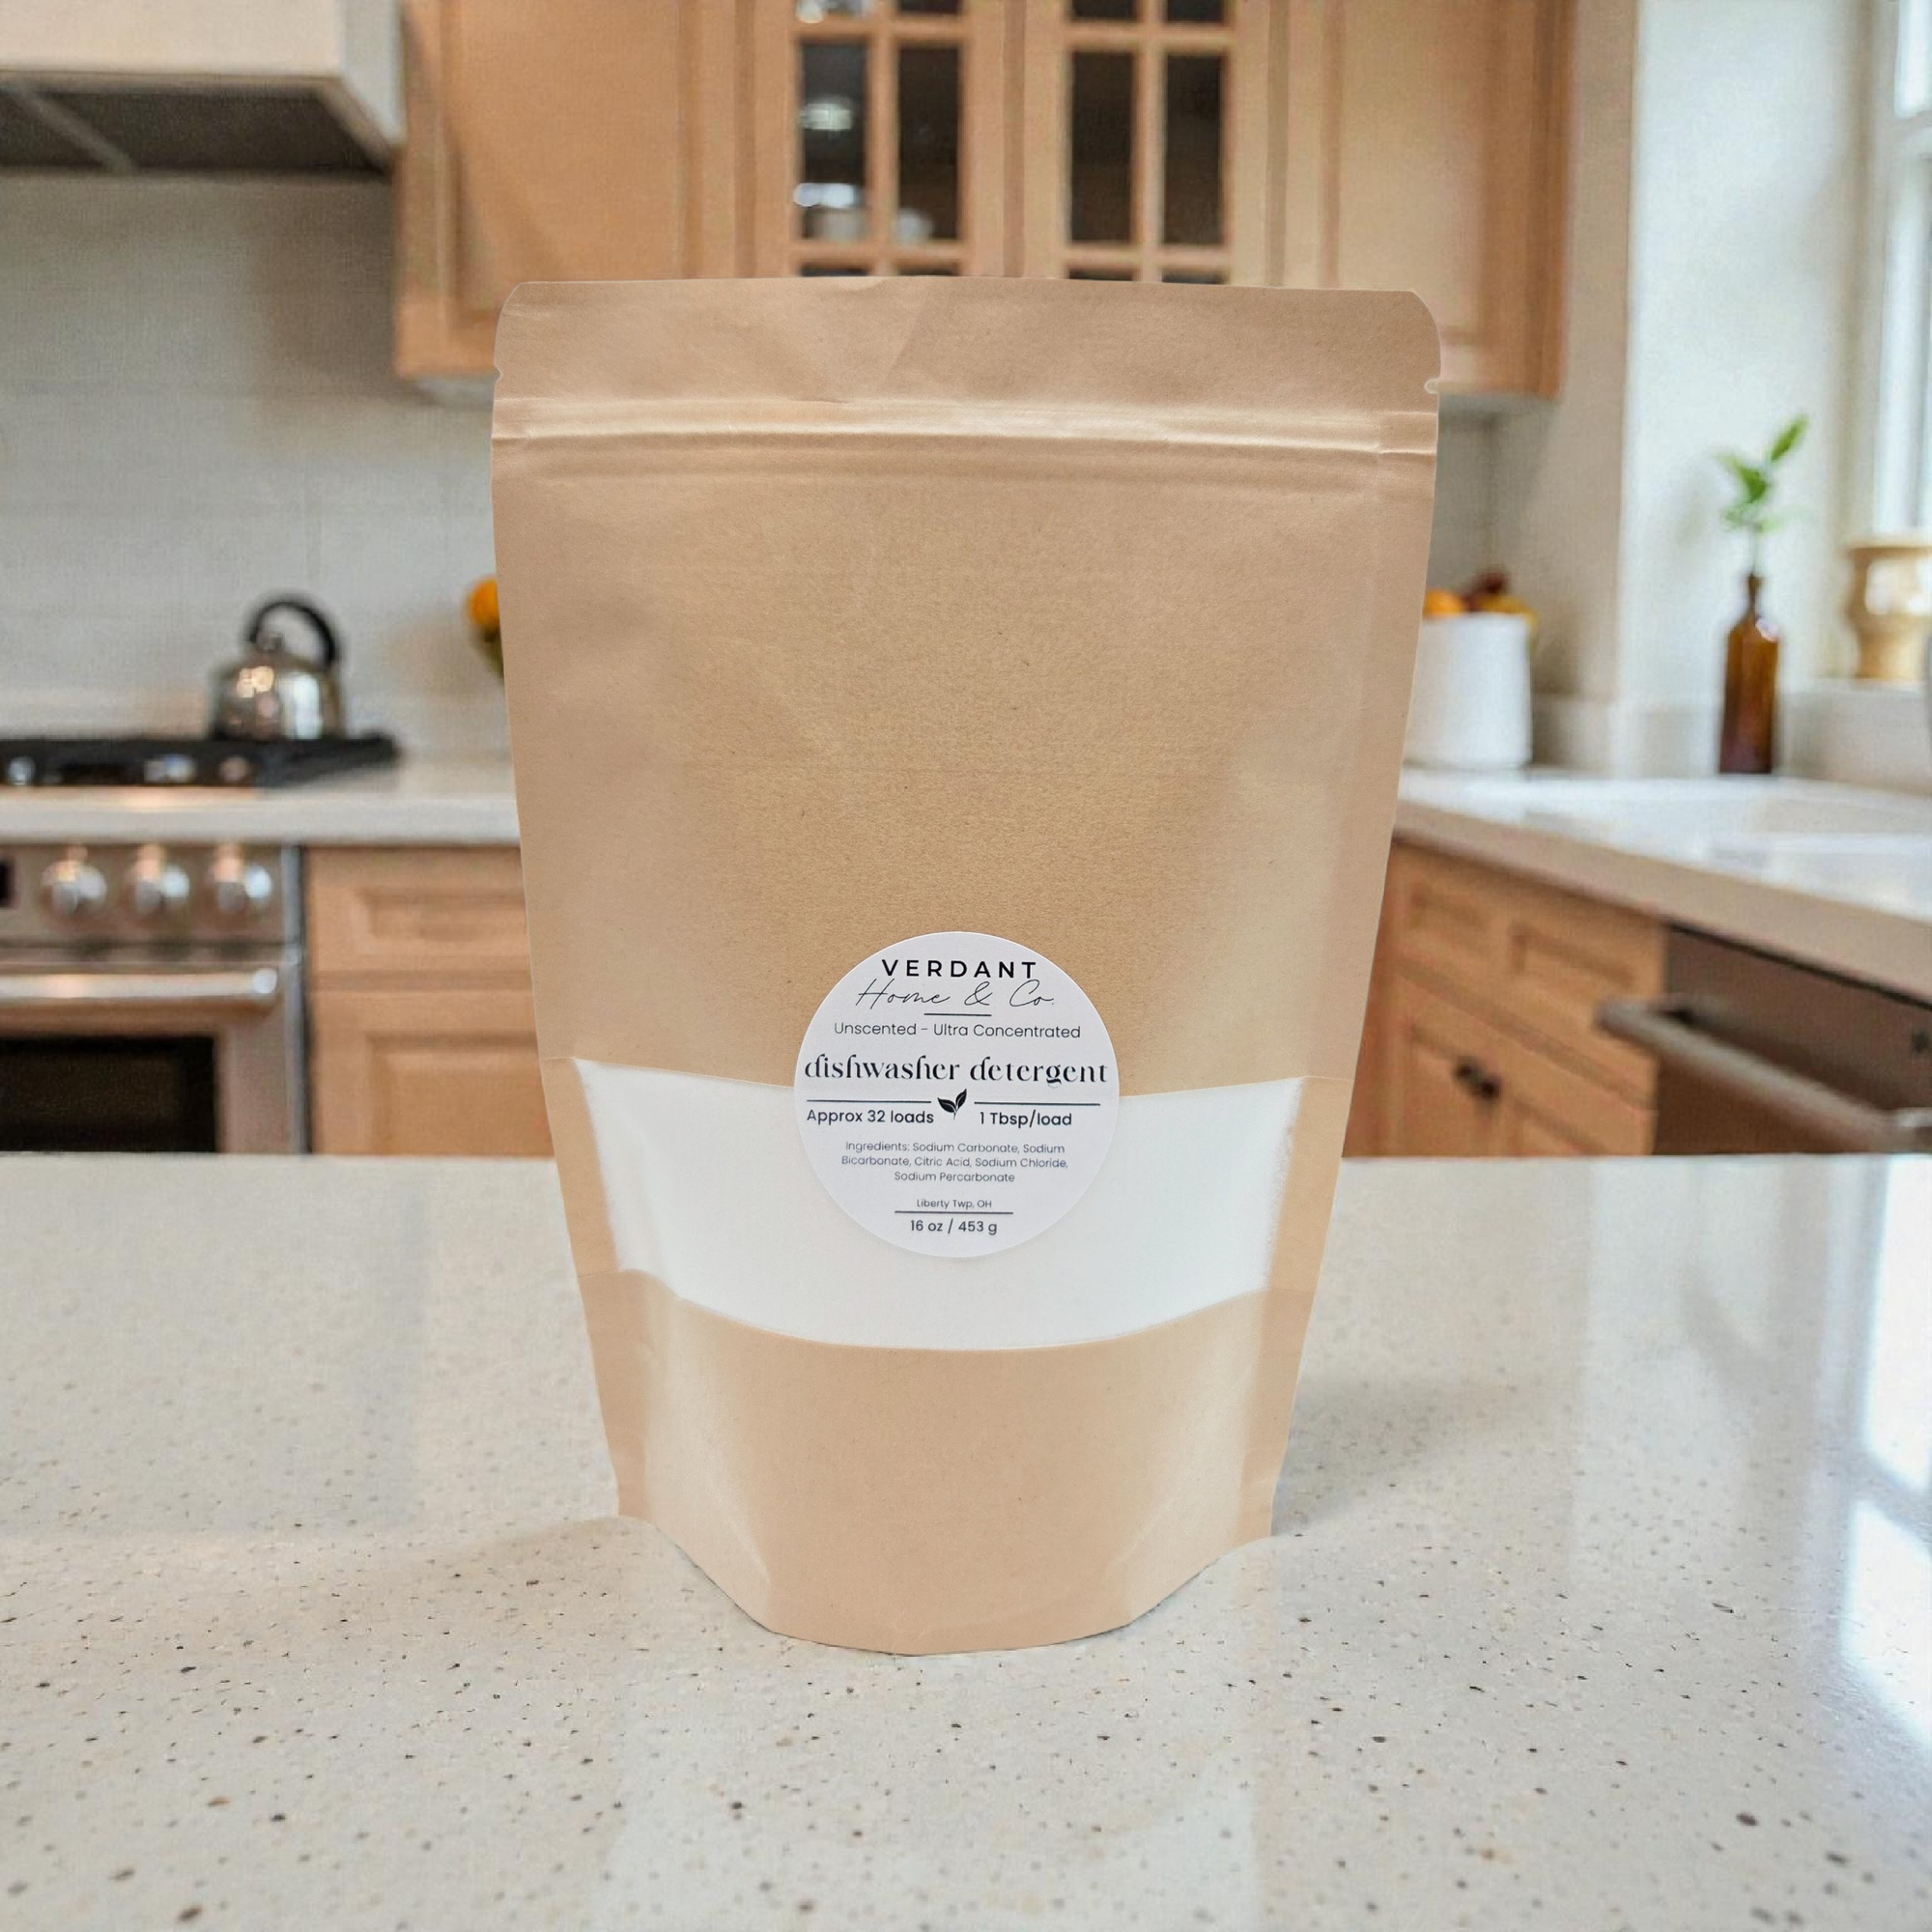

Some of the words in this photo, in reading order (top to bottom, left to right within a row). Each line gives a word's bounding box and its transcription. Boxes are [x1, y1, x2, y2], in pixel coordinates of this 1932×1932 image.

[881, 959, 1037, 979] VERDANT
[856, 979, 952, 1009] Home
[963, 981, 993, 1006] &
[1009, 980, 1055, 1008] Co.
[834, 1022, 917, 1036] Unscented
[933, 1023, 969, 1037] Ultra
[973, 1024, 1081, 1038] Concentrated
[804, 1054, 960, 1081] dishwasher
[970, 1057, 1108, 1089] detergent
[806, 1109, 863, 1124] Approx
[867, 1111, 886, 1123] 32
[890, 1111, 934, 1124] loads
[990, 1109, 1072, 1128] Tbsp/load
[845, 1142, 910, 1154] Ingredients:
[912, 1143, 955, 1152] Sodium
[957, 1143, 1020, 1155] Carbonate,
[1023, 1144, 1065, 1153] Sodium
[841, 1155, 912, 1167] Bicarbonate,
[915, 1157, 943, 1167] Citric
[946, 1157, 973, 1168] Acid,
[975, 1157, 1017, 1167] Sodium
[1020, 1158, 1068, 1169] Chloride,
[895, 1172, 937, 1181] Sodium
[939, 1173, 1015, 1182] Percarbonate
[916, 1199, 950, 1209] Liberty
[952, 1200, 975, 1209] Twp,
[977, 1200, 992, 1208] OH
[910, 1221, 923, 1232] 16
[927, 1222, 944, 1232] oz
[957, 1221, 984, 1233] 453
[988, 1223, 998, 1235] g
